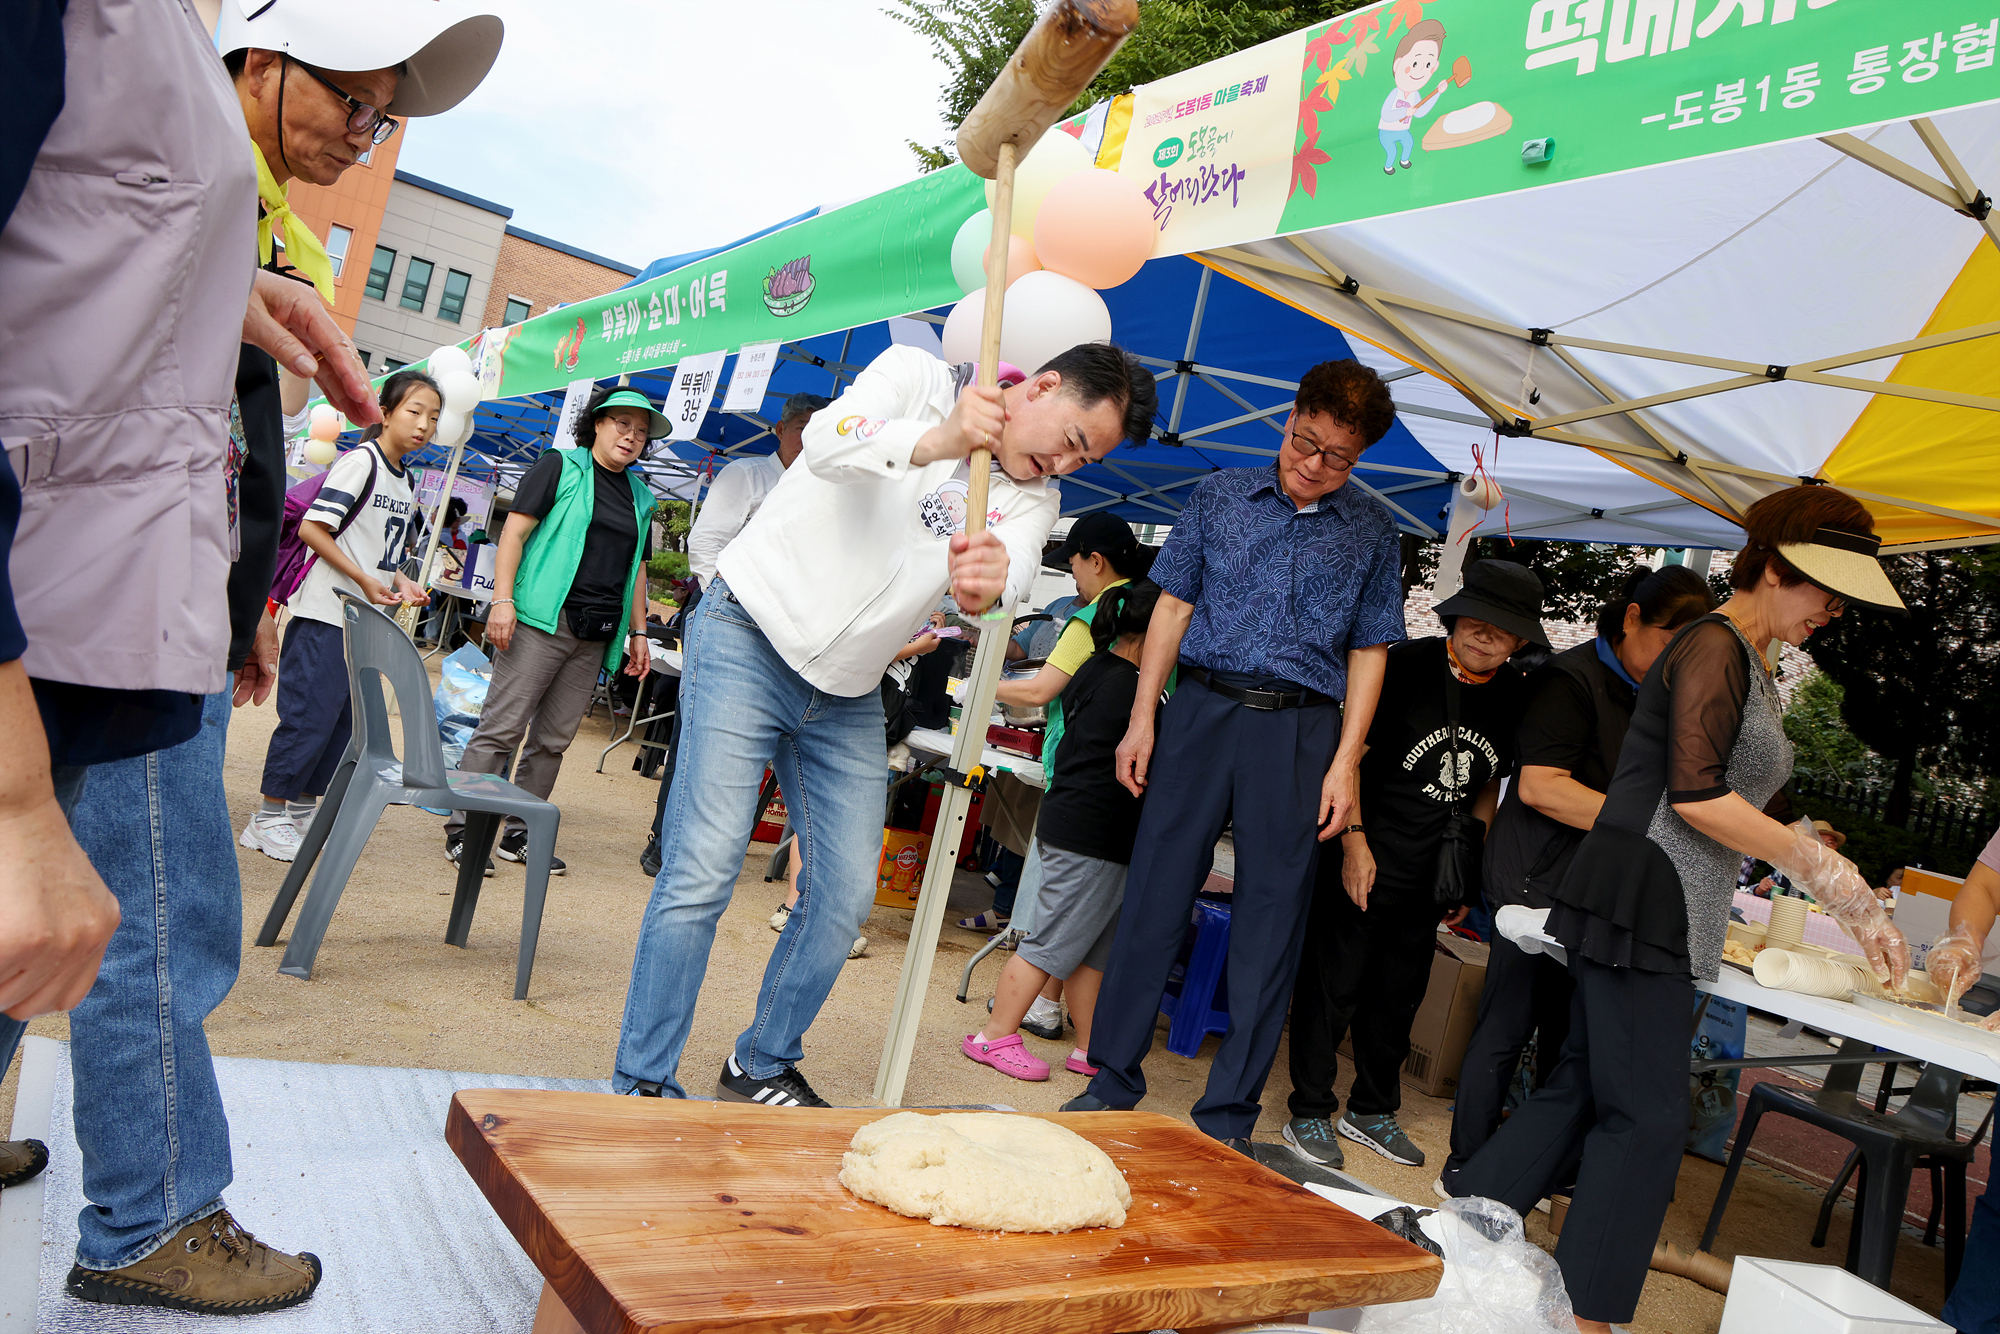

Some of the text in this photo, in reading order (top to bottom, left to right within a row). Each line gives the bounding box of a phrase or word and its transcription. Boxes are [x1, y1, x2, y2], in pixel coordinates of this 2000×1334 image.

[1846, 17, 2000, 95] 통장협
[1174, 92, 1213, 119] 도봉1동
[1213, 75, 1269, 106] 마을축제
[1157, 144, 1180, 161] 제3회
[681, 370, 713, 396] 떡볶이
